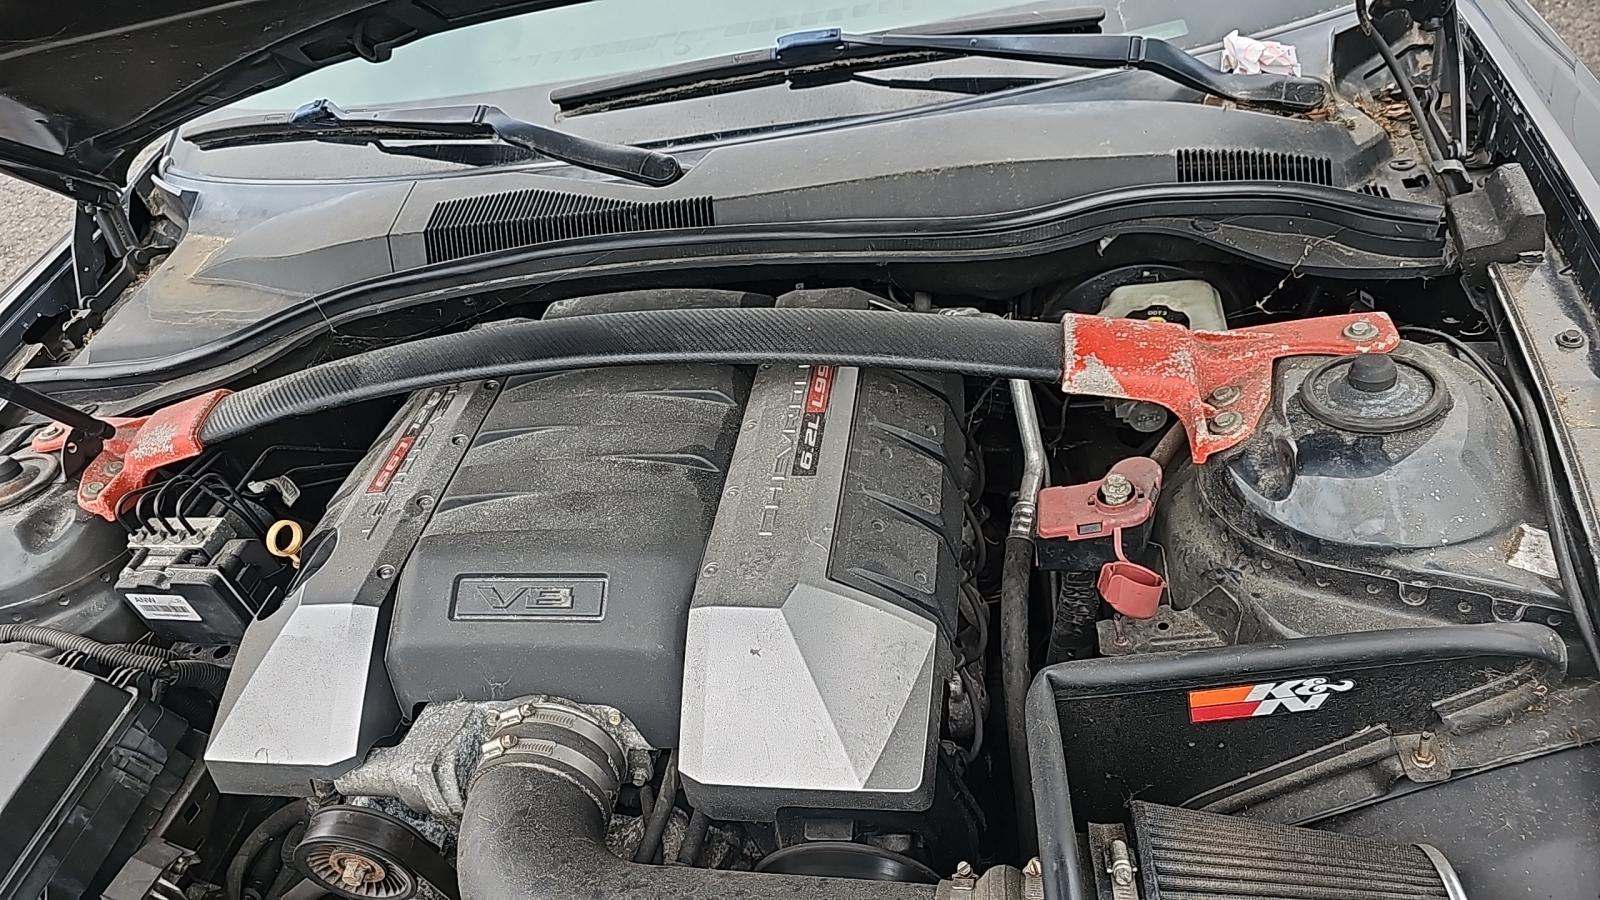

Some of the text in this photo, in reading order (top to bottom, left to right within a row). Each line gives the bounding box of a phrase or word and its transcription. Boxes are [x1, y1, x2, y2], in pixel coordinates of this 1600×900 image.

[800, 414, 821, 471] 6.2L
[374, 441, 409, 488] L99
[478, 586, 574, 609] V8
[1245, 677, 1355, 717] K&N
